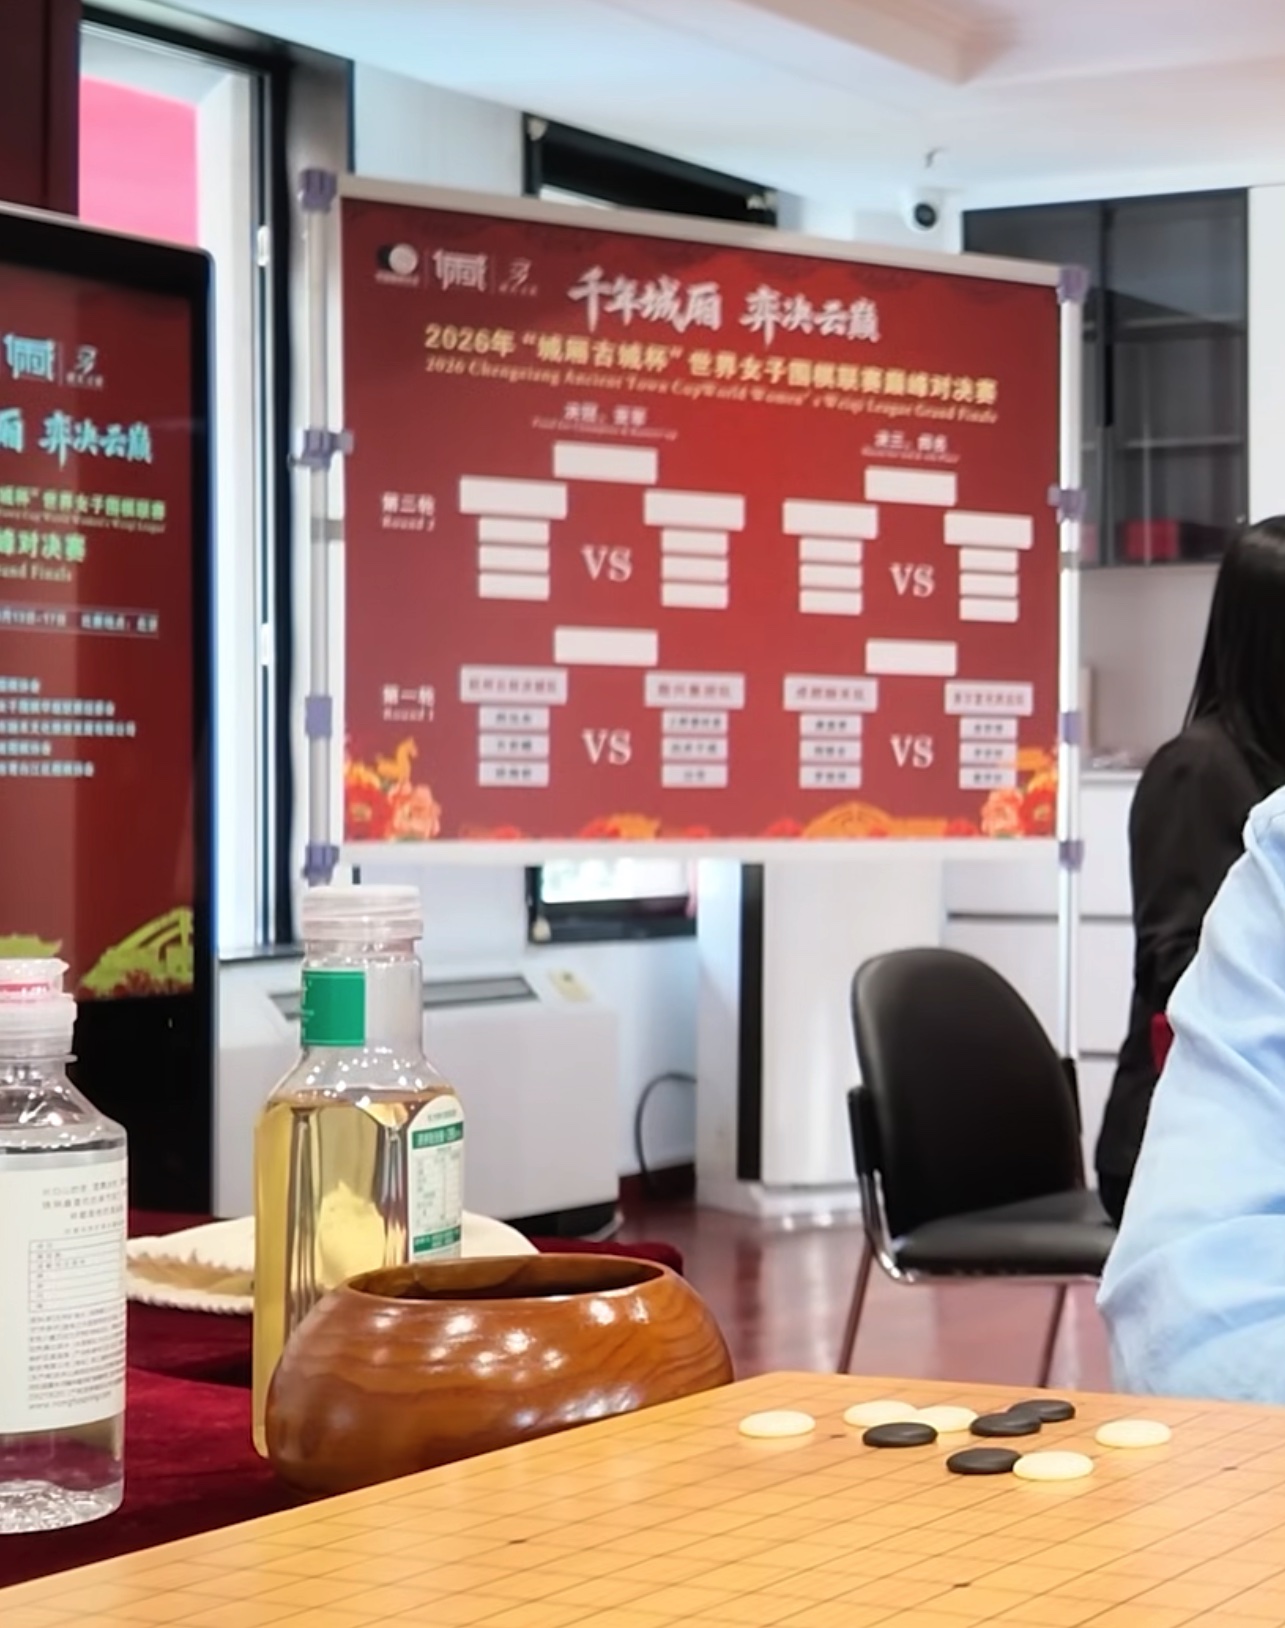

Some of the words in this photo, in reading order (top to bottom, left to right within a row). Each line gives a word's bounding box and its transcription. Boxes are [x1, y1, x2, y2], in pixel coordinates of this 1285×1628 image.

[582, 545, 632, 582] VS
[889, 562, 935, 598] VS
[582, 728, 632, 765] VS
[890, 735, 934, 769] VS
